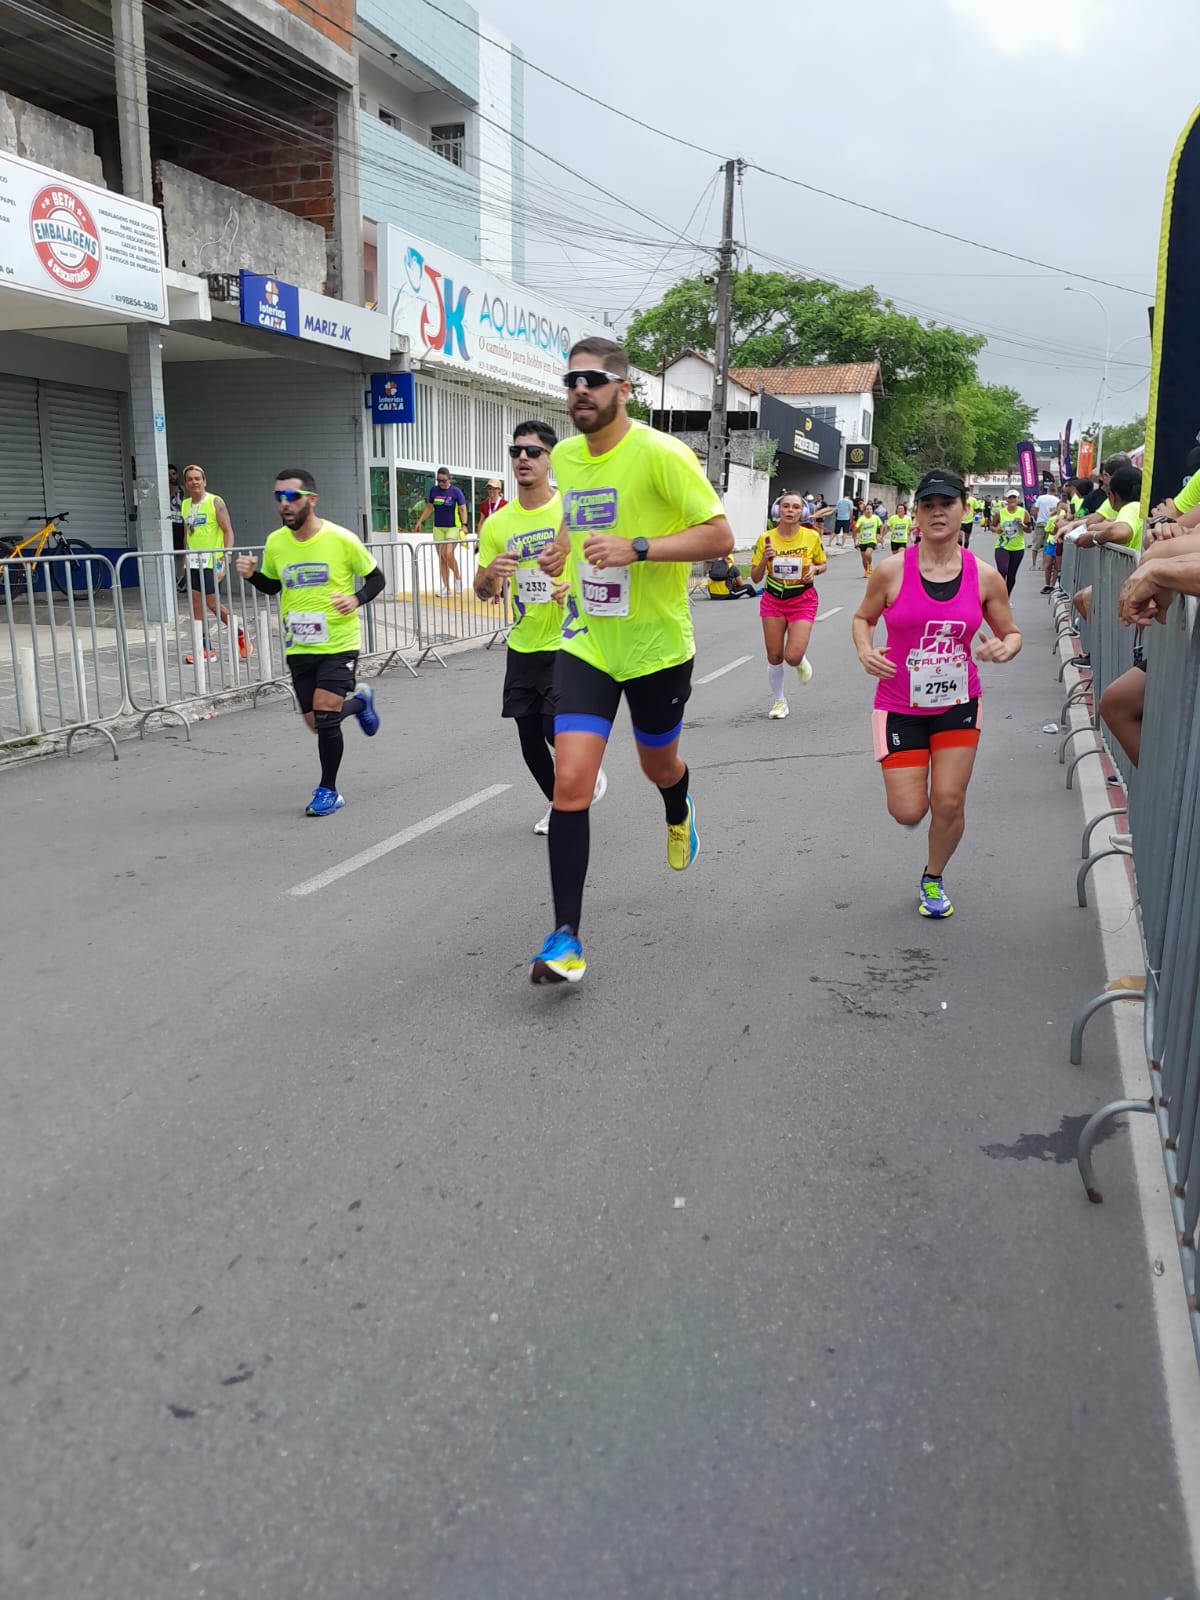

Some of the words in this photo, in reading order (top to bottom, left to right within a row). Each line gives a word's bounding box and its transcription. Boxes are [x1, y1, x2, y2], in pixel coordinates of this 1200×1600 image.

[51, 191, 75, 211] BETH
[34, 223, 97, 256] EMBALAGENS
[259, 300, 286, 319] loterias
[420, 264, 471, 362] JK
[258, 314, 287, 331] CAIXA
[304, 314, 337, 337] MARIZ
[340, 325, 352, 341] JK
[479, 291, 571, 360] AQUARISMO
[478, 335, 485, 350] O
[486, 342, 512, 360] caminho
[377, 403, 404, 411] CAIXA
[378, 395, 404, 403] loterias
[522, 531, 554, 545] CORRIDA
[525, 581, 547, 592] 2332
[583, 583, 609, 601] 1018
[925, 680, 957, 695] 2754
